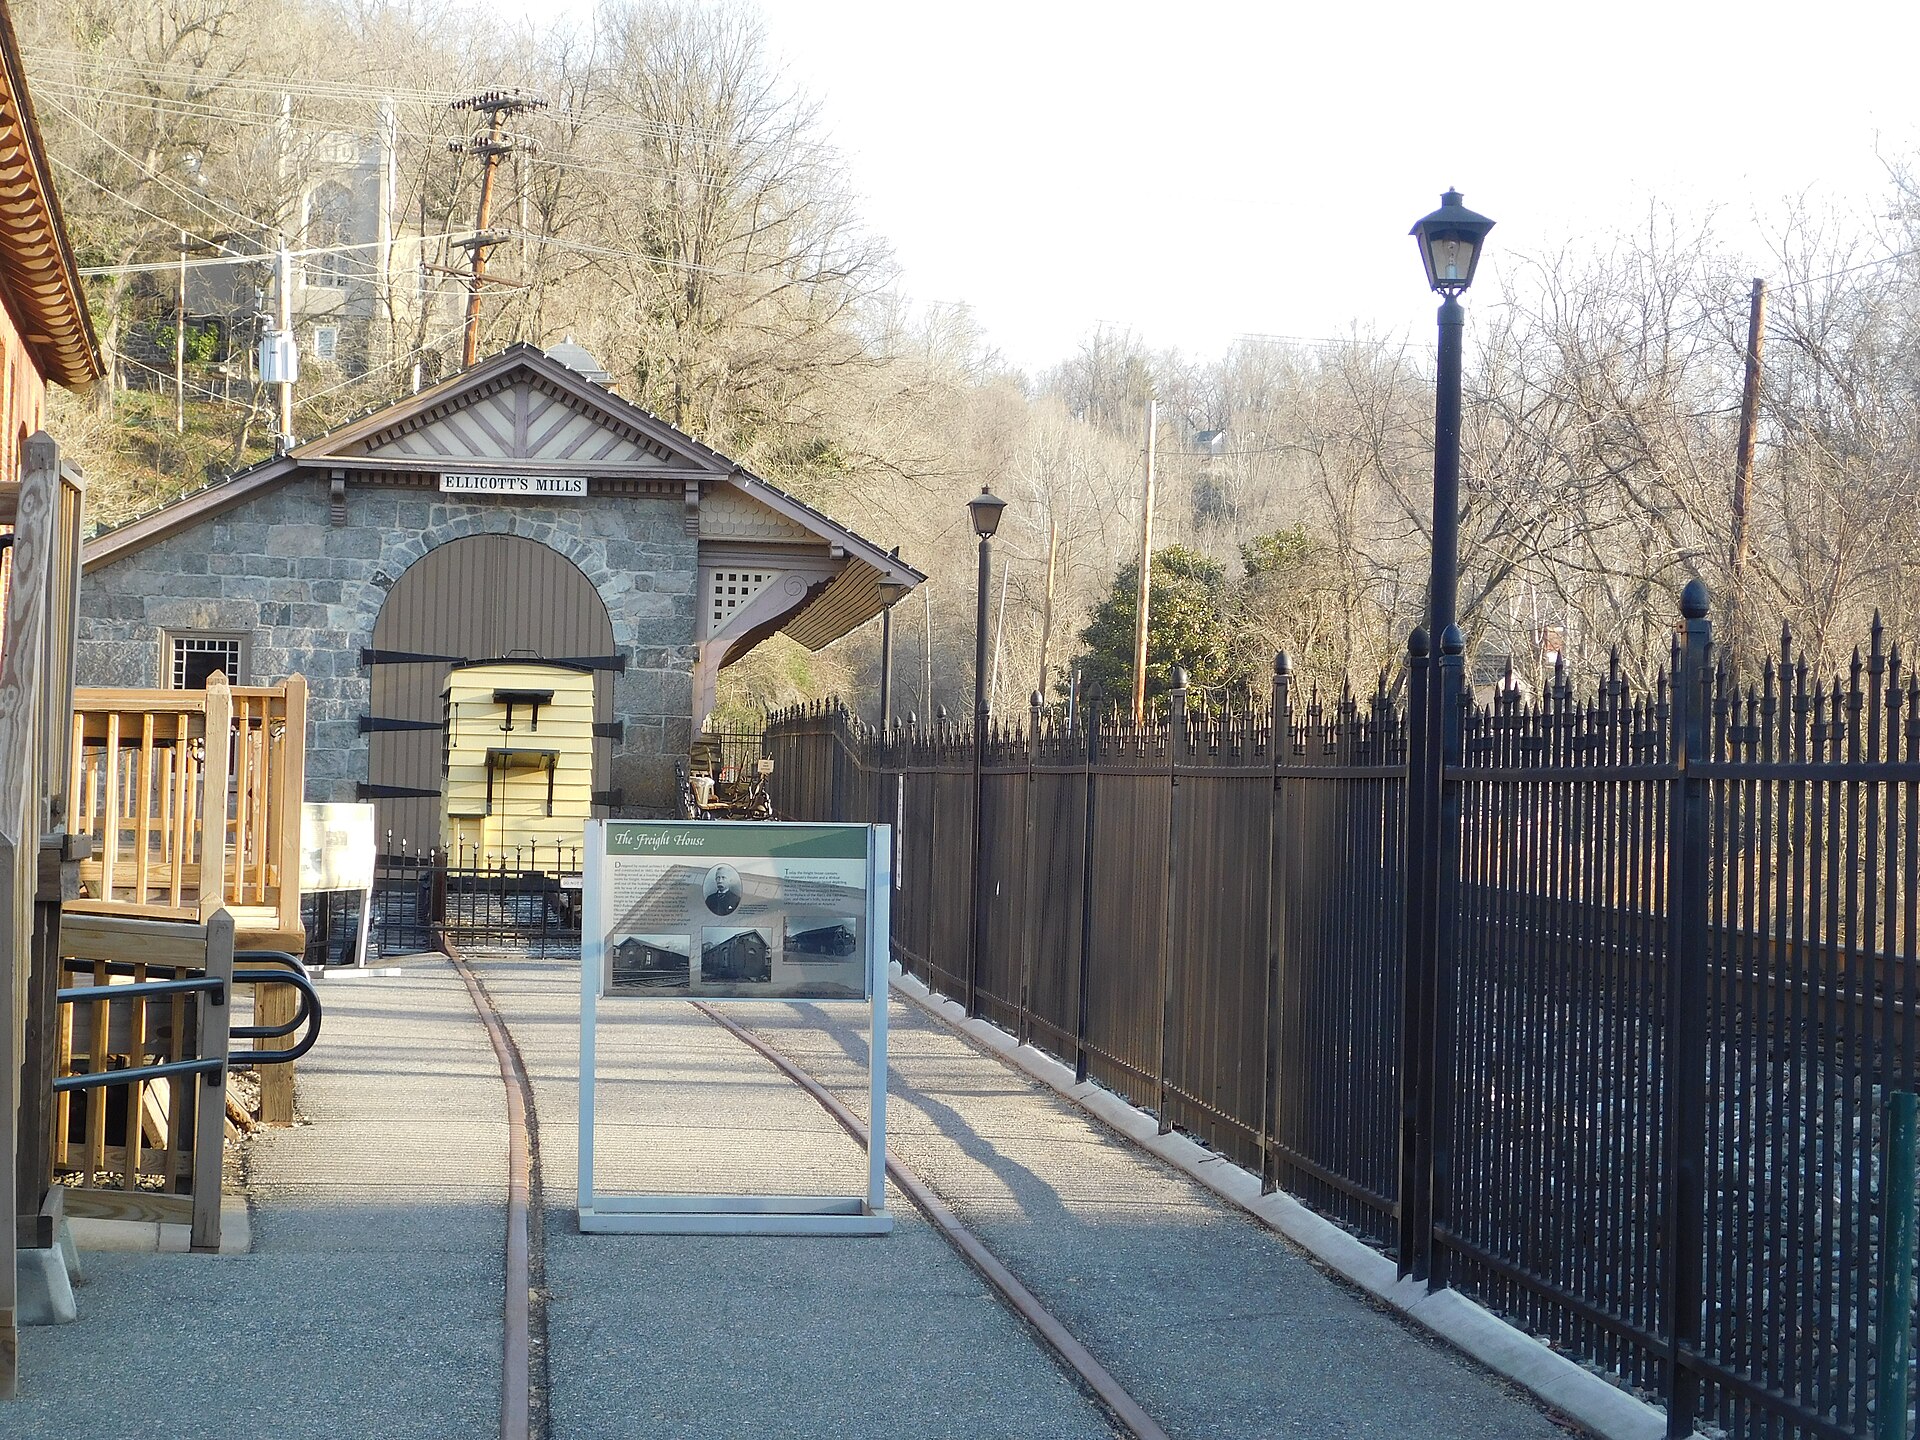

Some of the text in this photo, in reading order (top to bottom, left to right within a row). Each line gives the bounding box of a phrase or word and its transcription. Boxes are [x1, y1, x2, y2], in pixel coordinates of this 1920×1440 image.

[445, 476, 582, 492] ELLICOTT'S MILLS
[614, 829, 705, 851] The Freight House
